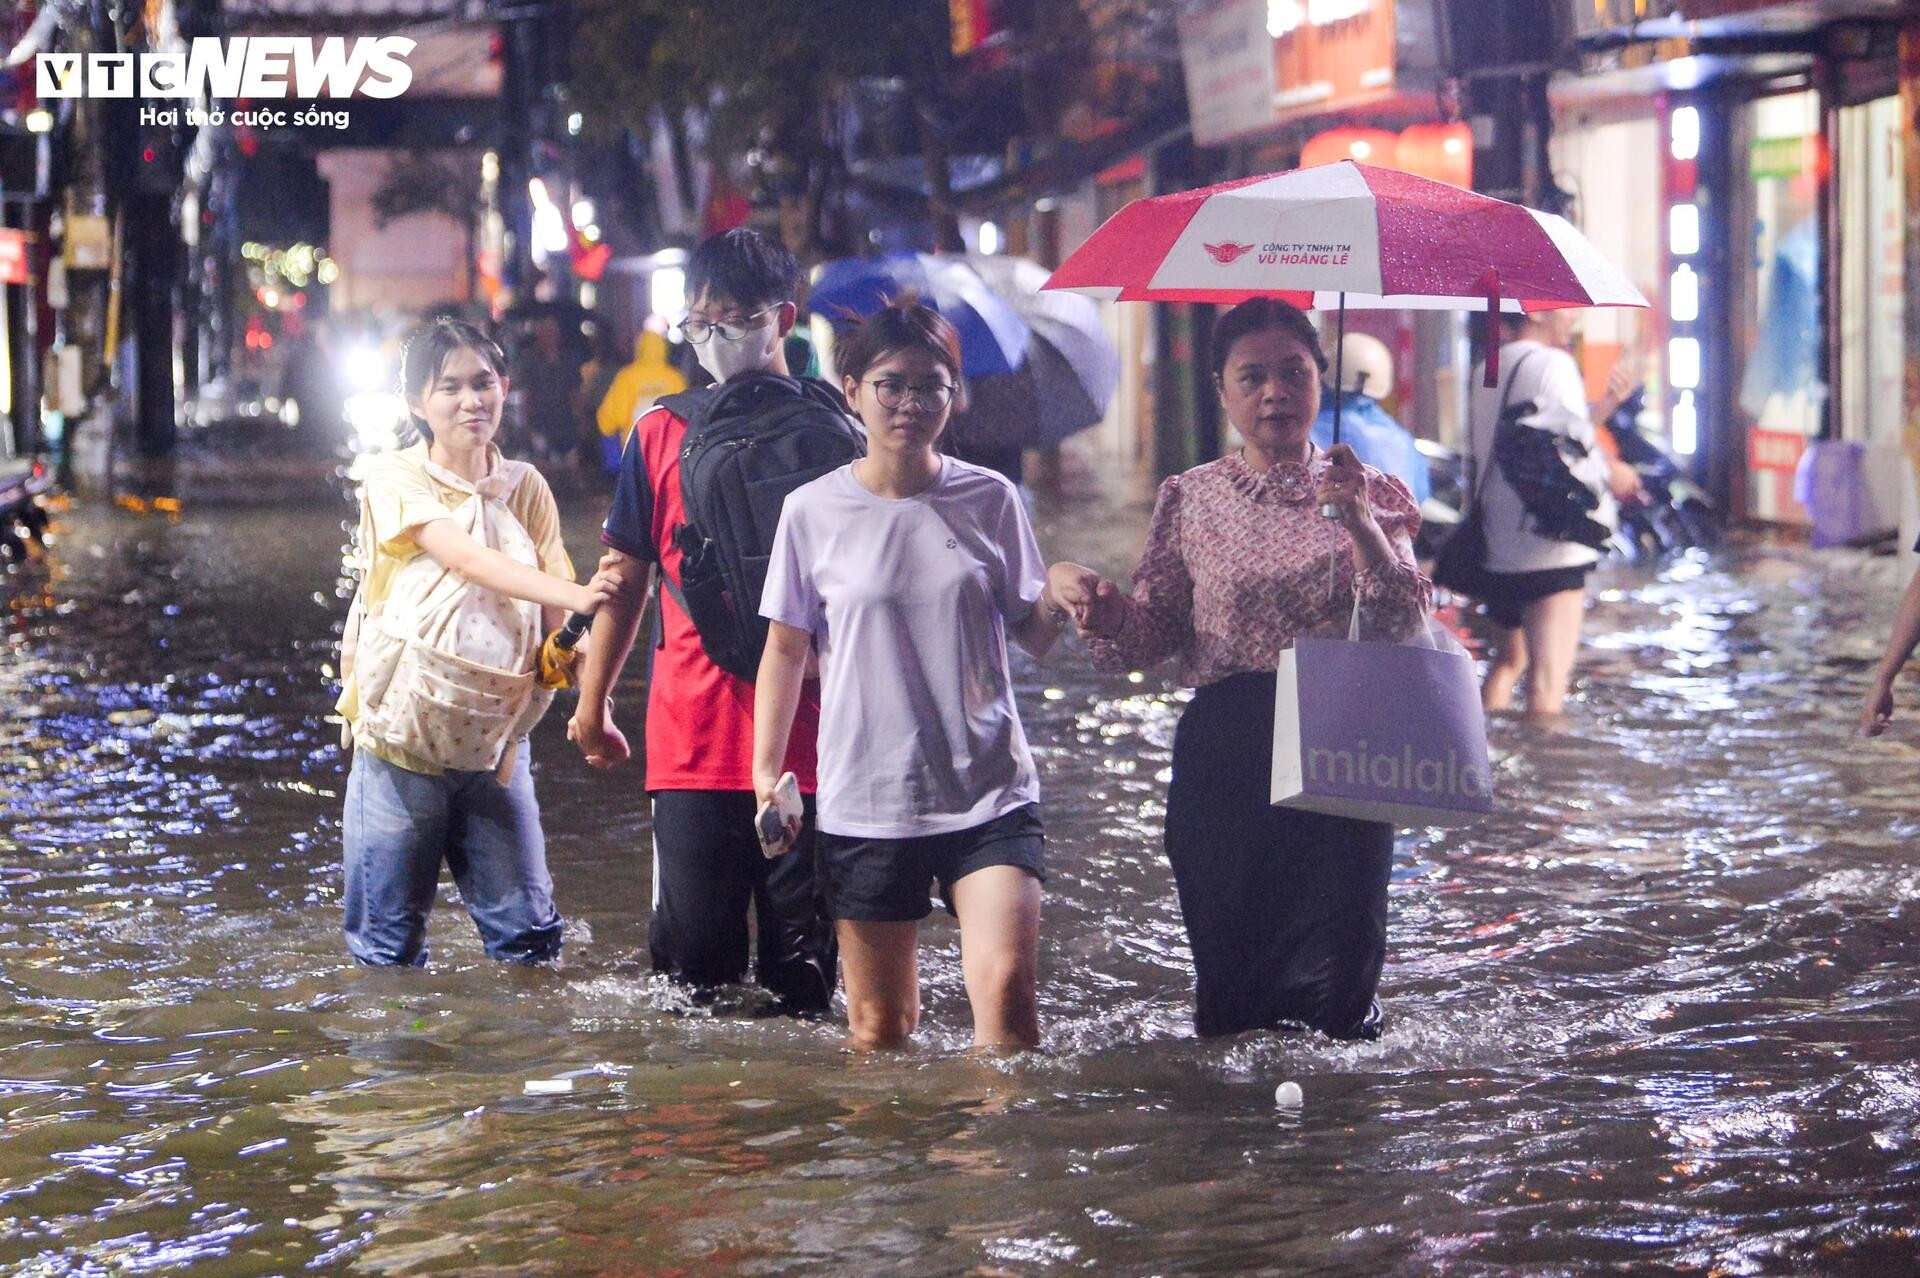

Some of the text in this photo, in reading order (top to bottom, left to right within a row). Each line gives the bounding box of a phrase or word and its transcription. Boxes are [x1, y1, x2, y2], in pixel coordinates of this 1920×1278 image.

[1292, 244, 1304, 252] TY
[1306, 244, 1334, 252] TNHH
[1336, 244, 1351, 252] TM
[1258, 252, 1277, 264] VŨ
[1308, 739, 1489, 797] mialala
